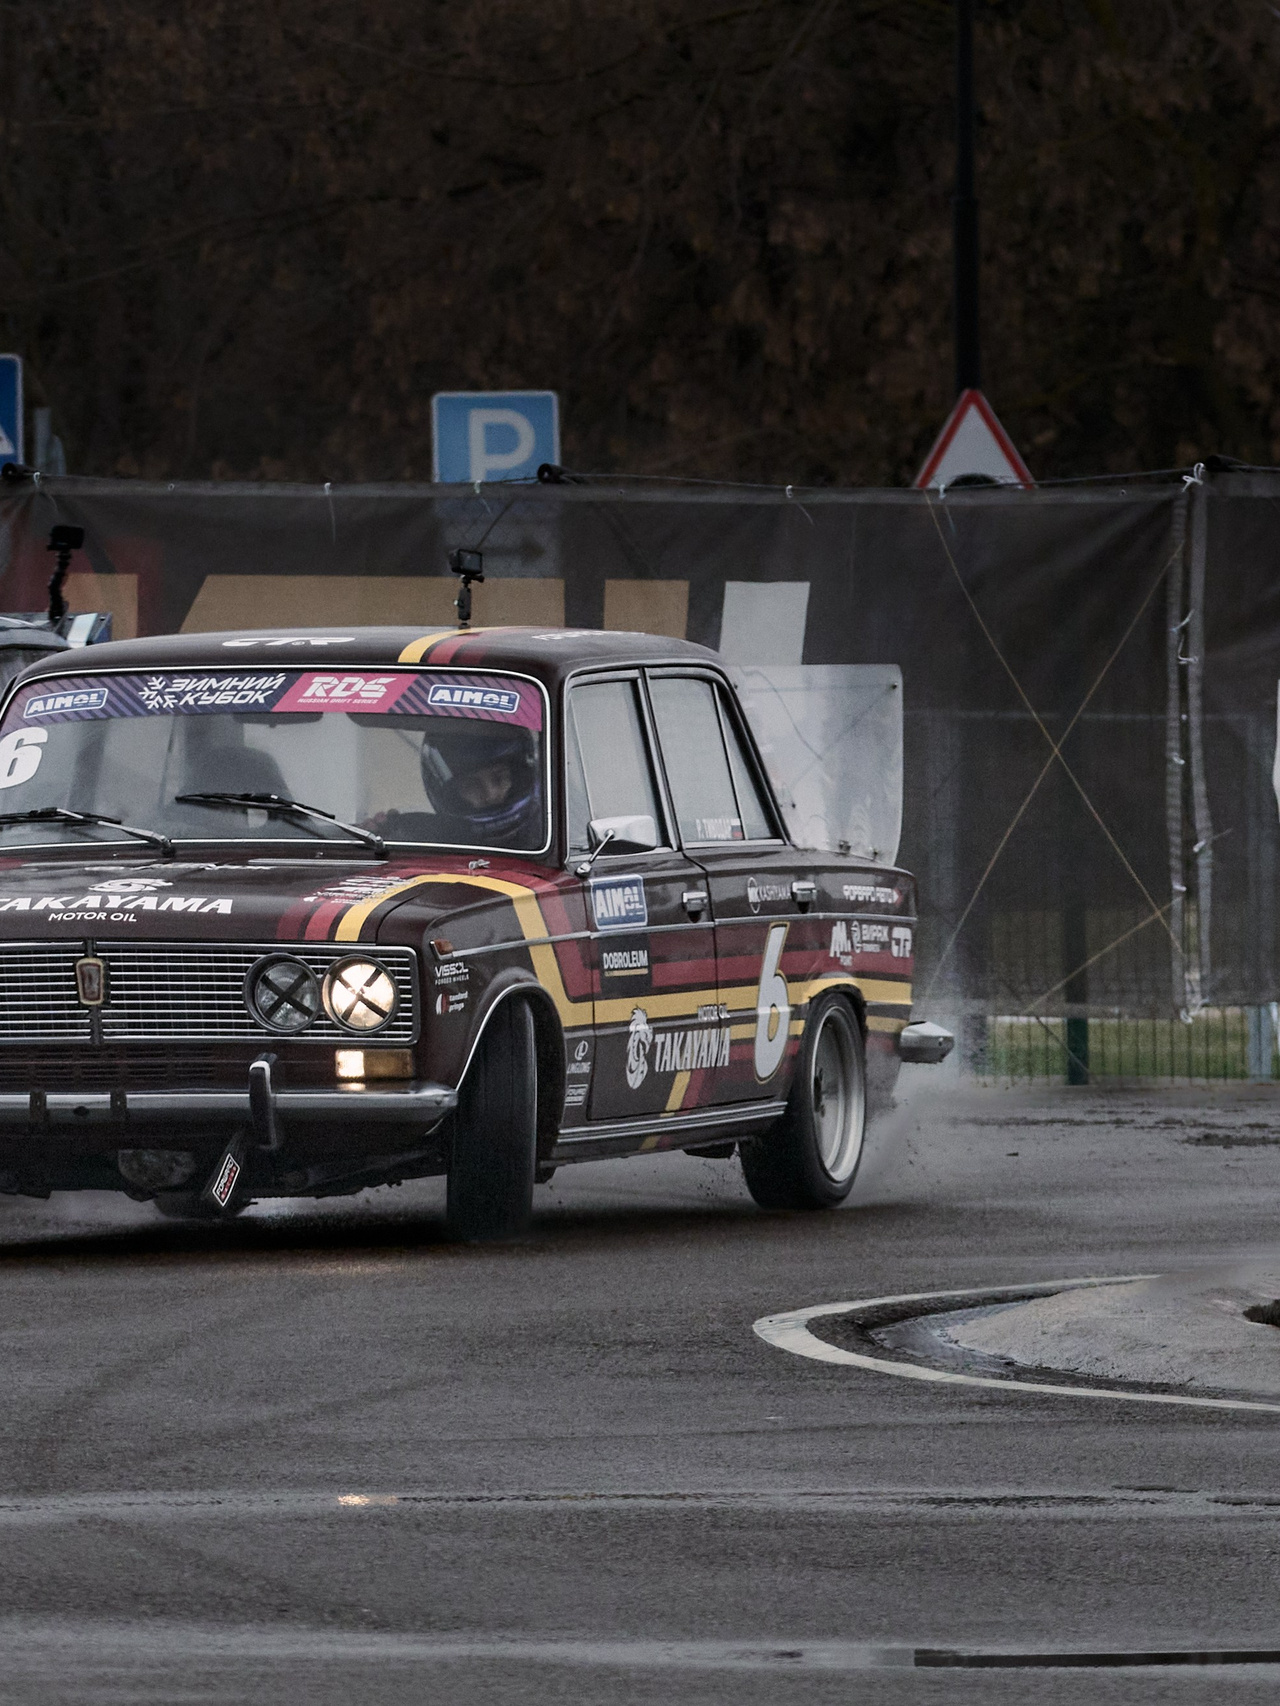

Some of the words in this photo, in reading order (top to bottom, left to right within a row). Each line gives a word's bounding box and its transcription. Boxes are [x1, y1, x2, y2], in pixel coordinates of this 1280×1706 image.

[468, 408, 536, 483] P
[165, 673, 286, 692] ЗИМНИЙ
[302, 676, 397, 698] RDS
[27, 693, 102, 714] AIMOL
[179, 690, 274, 705] КУБОК
[431, 689, 513, 709] AIMOL
[595, 886, 644, 918] AIMOL
[48, 911, 106, 922] MOTOR
[110, 913, 138, 922] OIL
[435, 961, 469, 977] VISSOL
[603, 950, 649, 969] DOBROLEUM
[754, 921, 790, 1084] 6
[654, 1027, 731, 1072] TAKAYAMA
